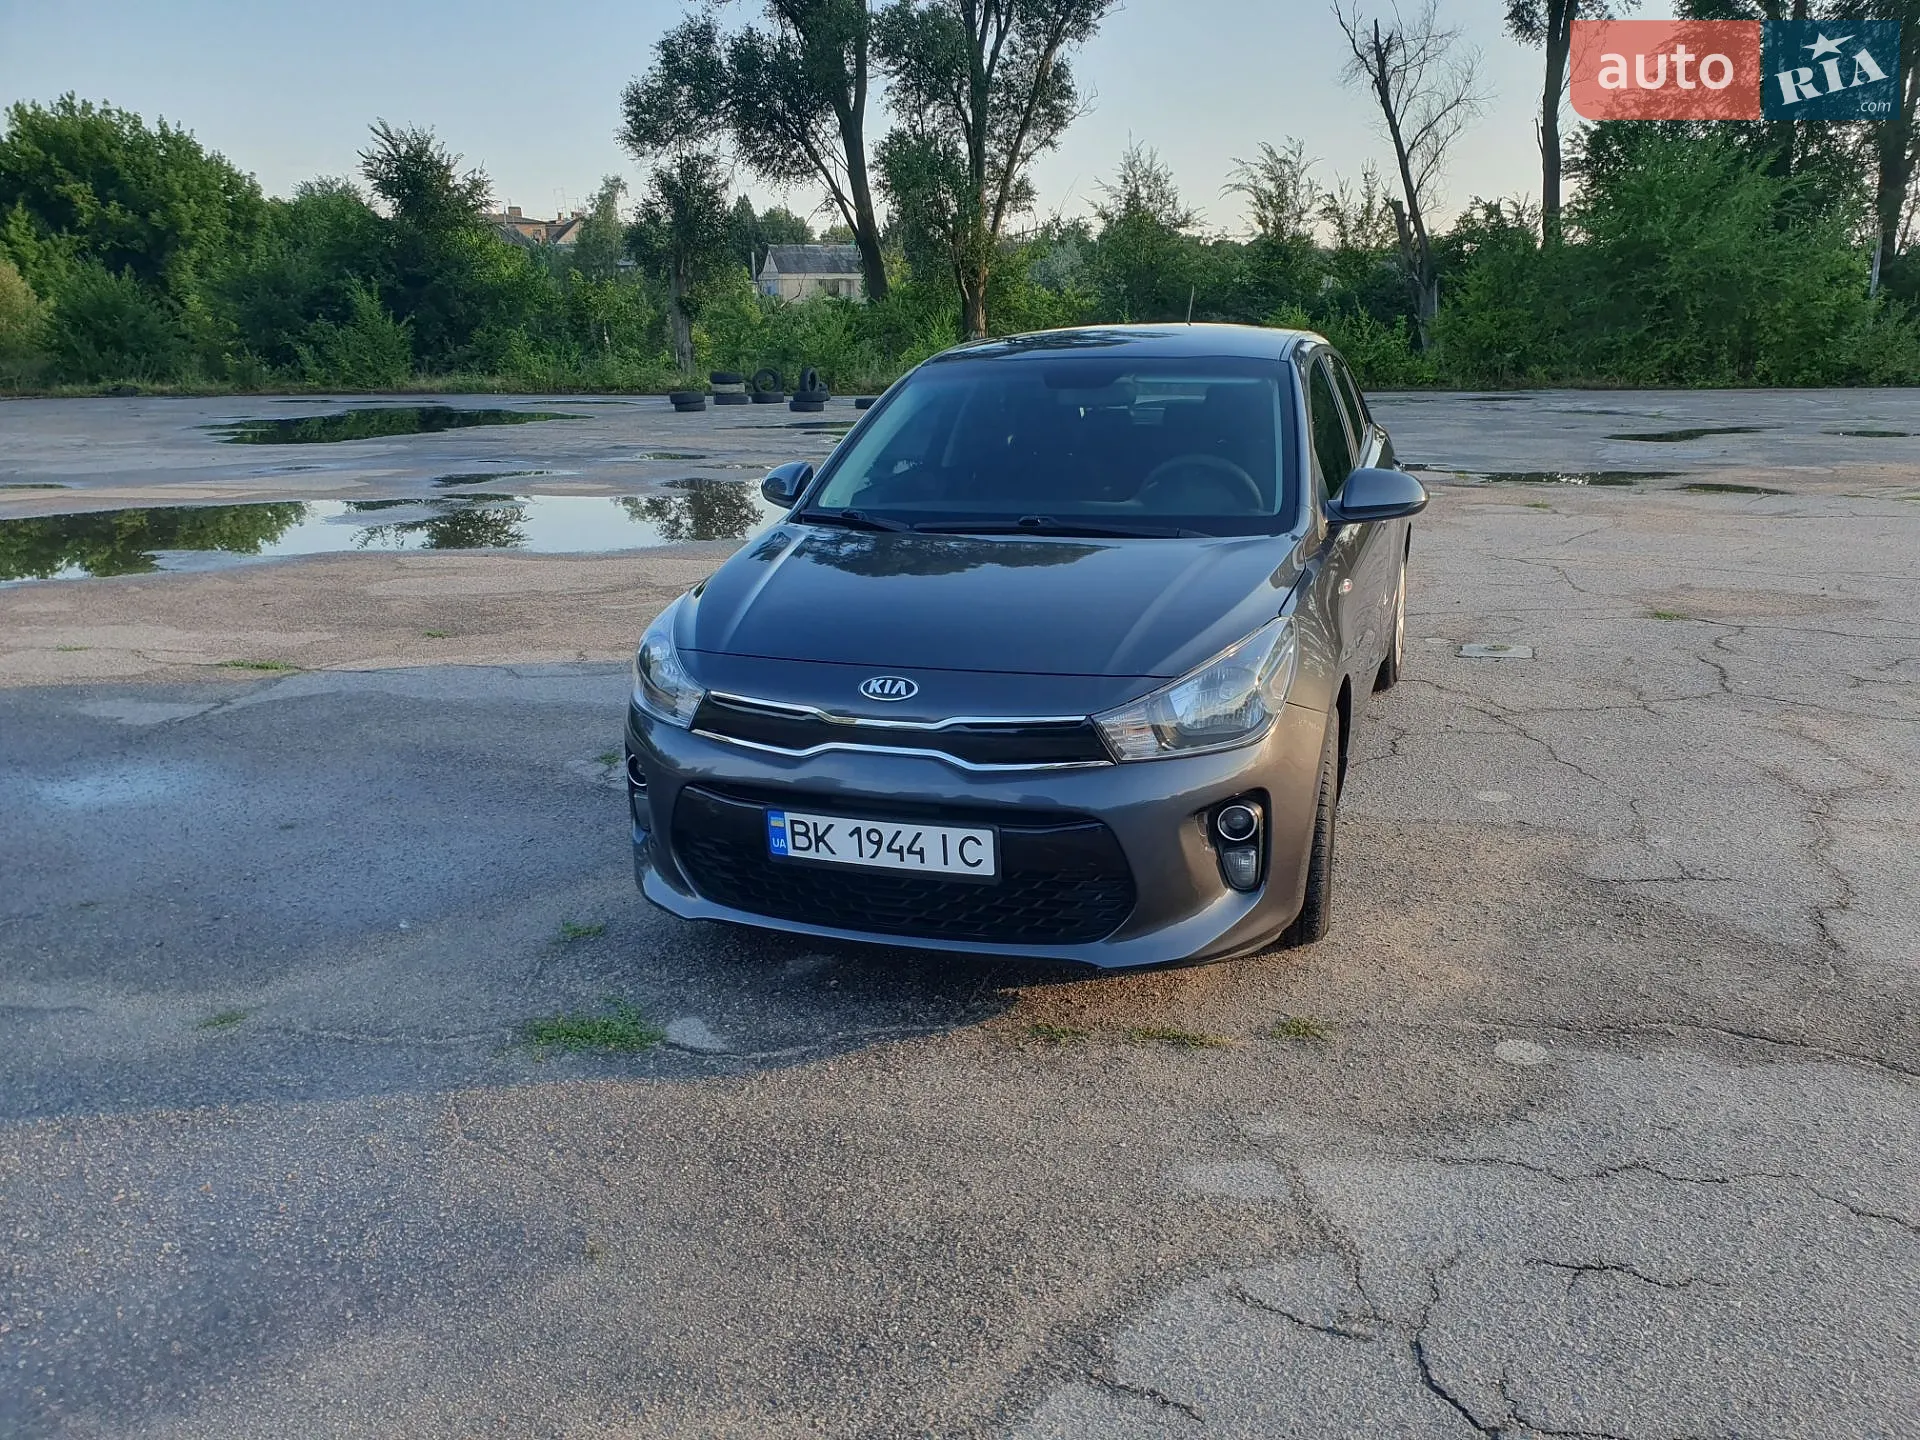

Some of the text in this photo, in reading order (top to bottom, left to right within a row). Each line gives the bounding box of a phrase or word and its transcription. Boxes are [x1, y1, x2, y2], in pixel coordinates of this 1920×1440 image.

[869, 680, 906, 695] KIA
[772, 838, 786, 848] UA
[790, 820, 983, 868] BK 1944 IC
